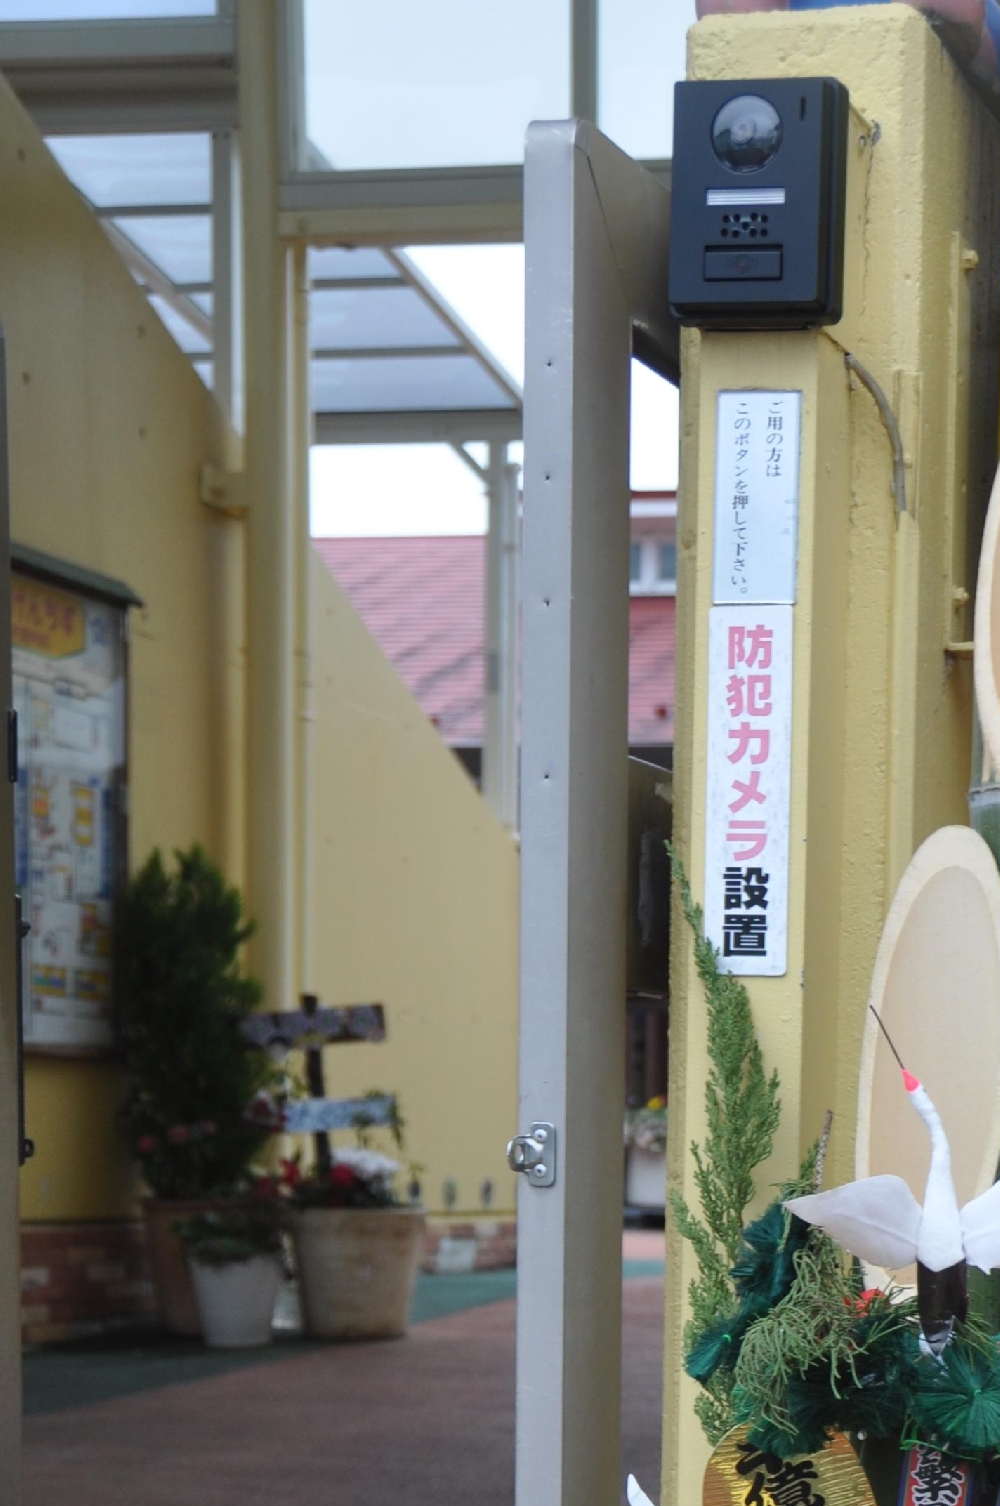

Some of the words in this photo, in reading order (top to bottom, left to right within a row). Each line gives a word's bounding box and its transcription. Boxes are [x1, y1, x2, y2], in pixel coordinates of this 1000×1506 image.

[731, 403, 752, 595] このボタンを押して下さい。
[766, 400, 784, 478] ご用の方は
[722, 624, 774, 958] 防犯カメラ設置
